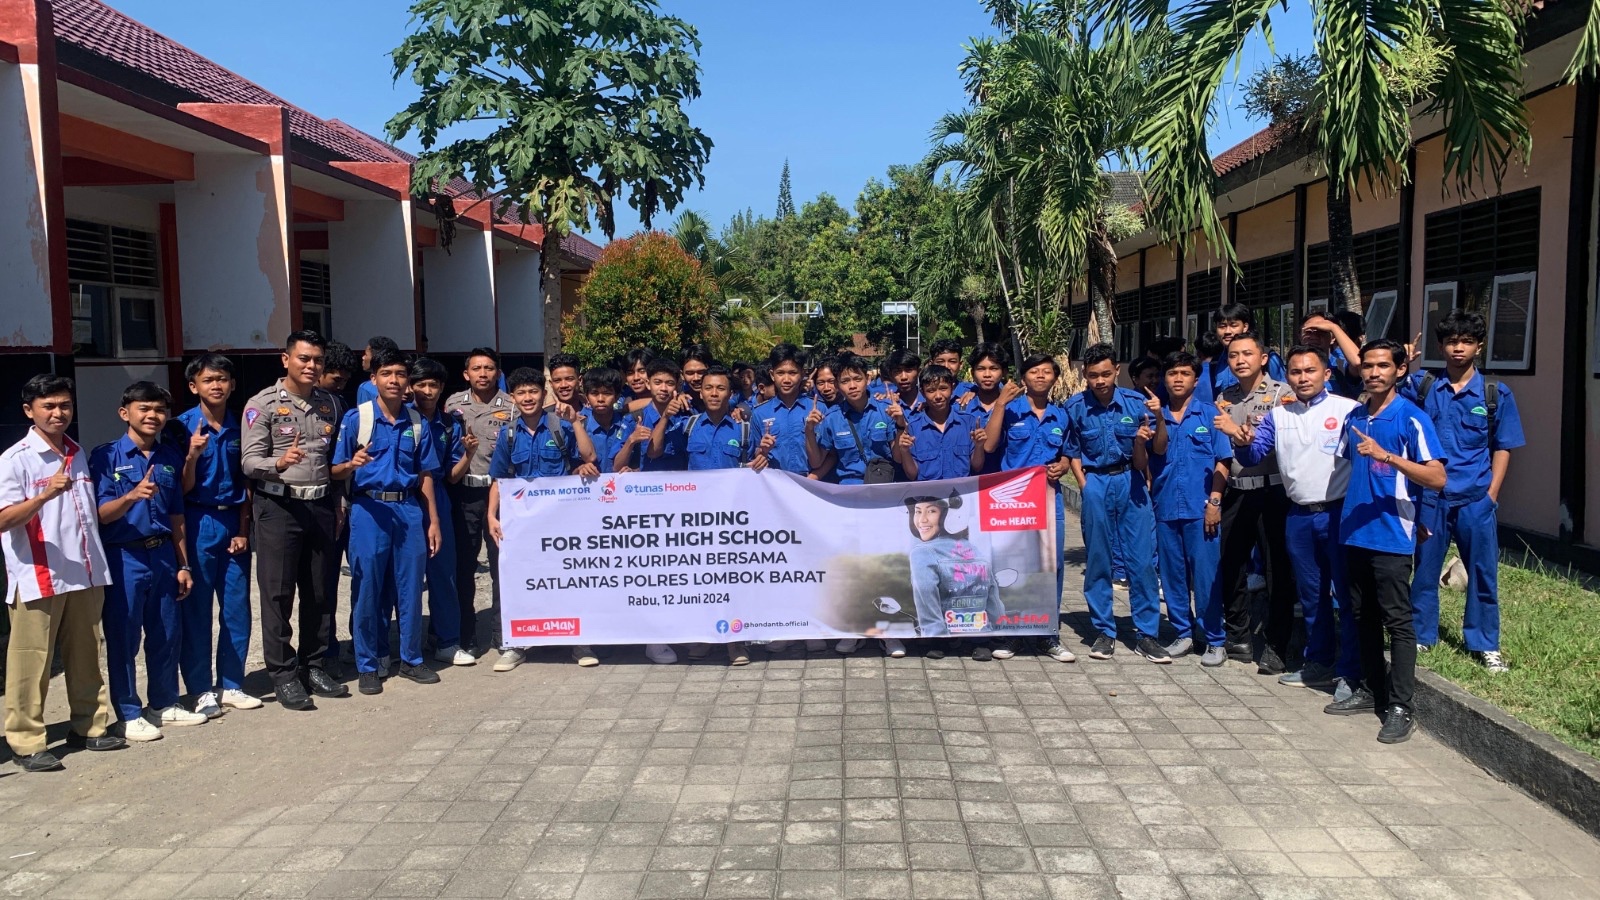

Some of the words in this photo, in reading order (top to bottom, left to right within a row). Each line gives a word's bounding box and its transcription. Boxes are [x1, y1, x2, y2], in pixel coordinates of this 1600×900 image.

[526, 487, 557, 497] ASTRA
[558, 485, 591, 496] MOTOR
[989, 502, 1037, 510] HONDA
[601, 513, 676, 530] SAFETY
[680, 510, 750, 528] RIDING
[990, 517, 1007, 527] One
[541, 535, 582, 552] FOR
[586, 533, 660, 550] SENIOR
[665, 531, 714, 548] HIGH
[718, 529, 802, 546] SCHOOL
[562, 556, 611, 570] SMKN
[613, 555, 624, 569] 2
[627, 553, 702, 568] KURIPAN
[706, 551, 788, 566] BERSAMA
[525, 575, 619, 591] SATLANTAS
[623, 573, 689, 588] POLRES
[693, 570, 765, 586] LOMBOK
[769, 570, 827, 584] BARAT
[628, 595, 661, 607] Rabu,
[662, 594, 676, 606] 12
[677, 593, 702, 605] Juni
[703, 592, 731, 604] 2024
[743, 620, 810, 630] @hondantb.official
[995, 614, 1050, 624] AHM
